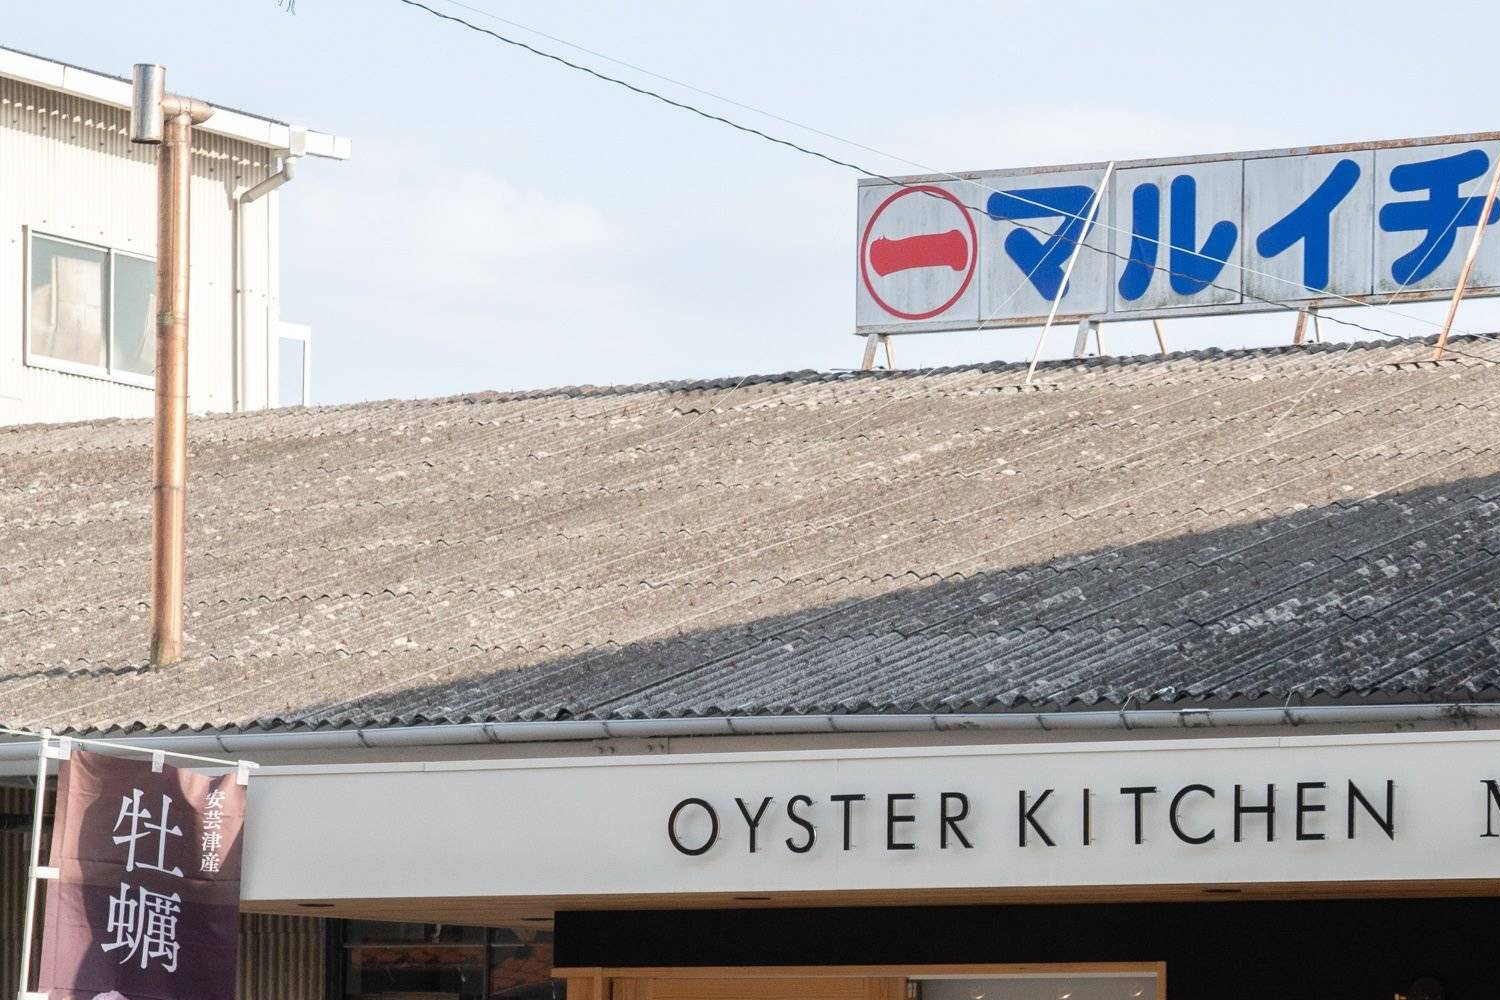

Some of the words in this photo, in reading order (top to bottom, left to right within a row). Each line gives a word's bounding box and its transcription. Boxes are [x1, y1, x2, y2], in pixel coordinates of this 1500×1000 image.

[200, 789, 226, 872] 安芸津産
[668, 792, 973, 856] OYSTER
[1019, 778, 1396, 848] KITCHEN
[101, 788, 184, 972] 牡蠣
